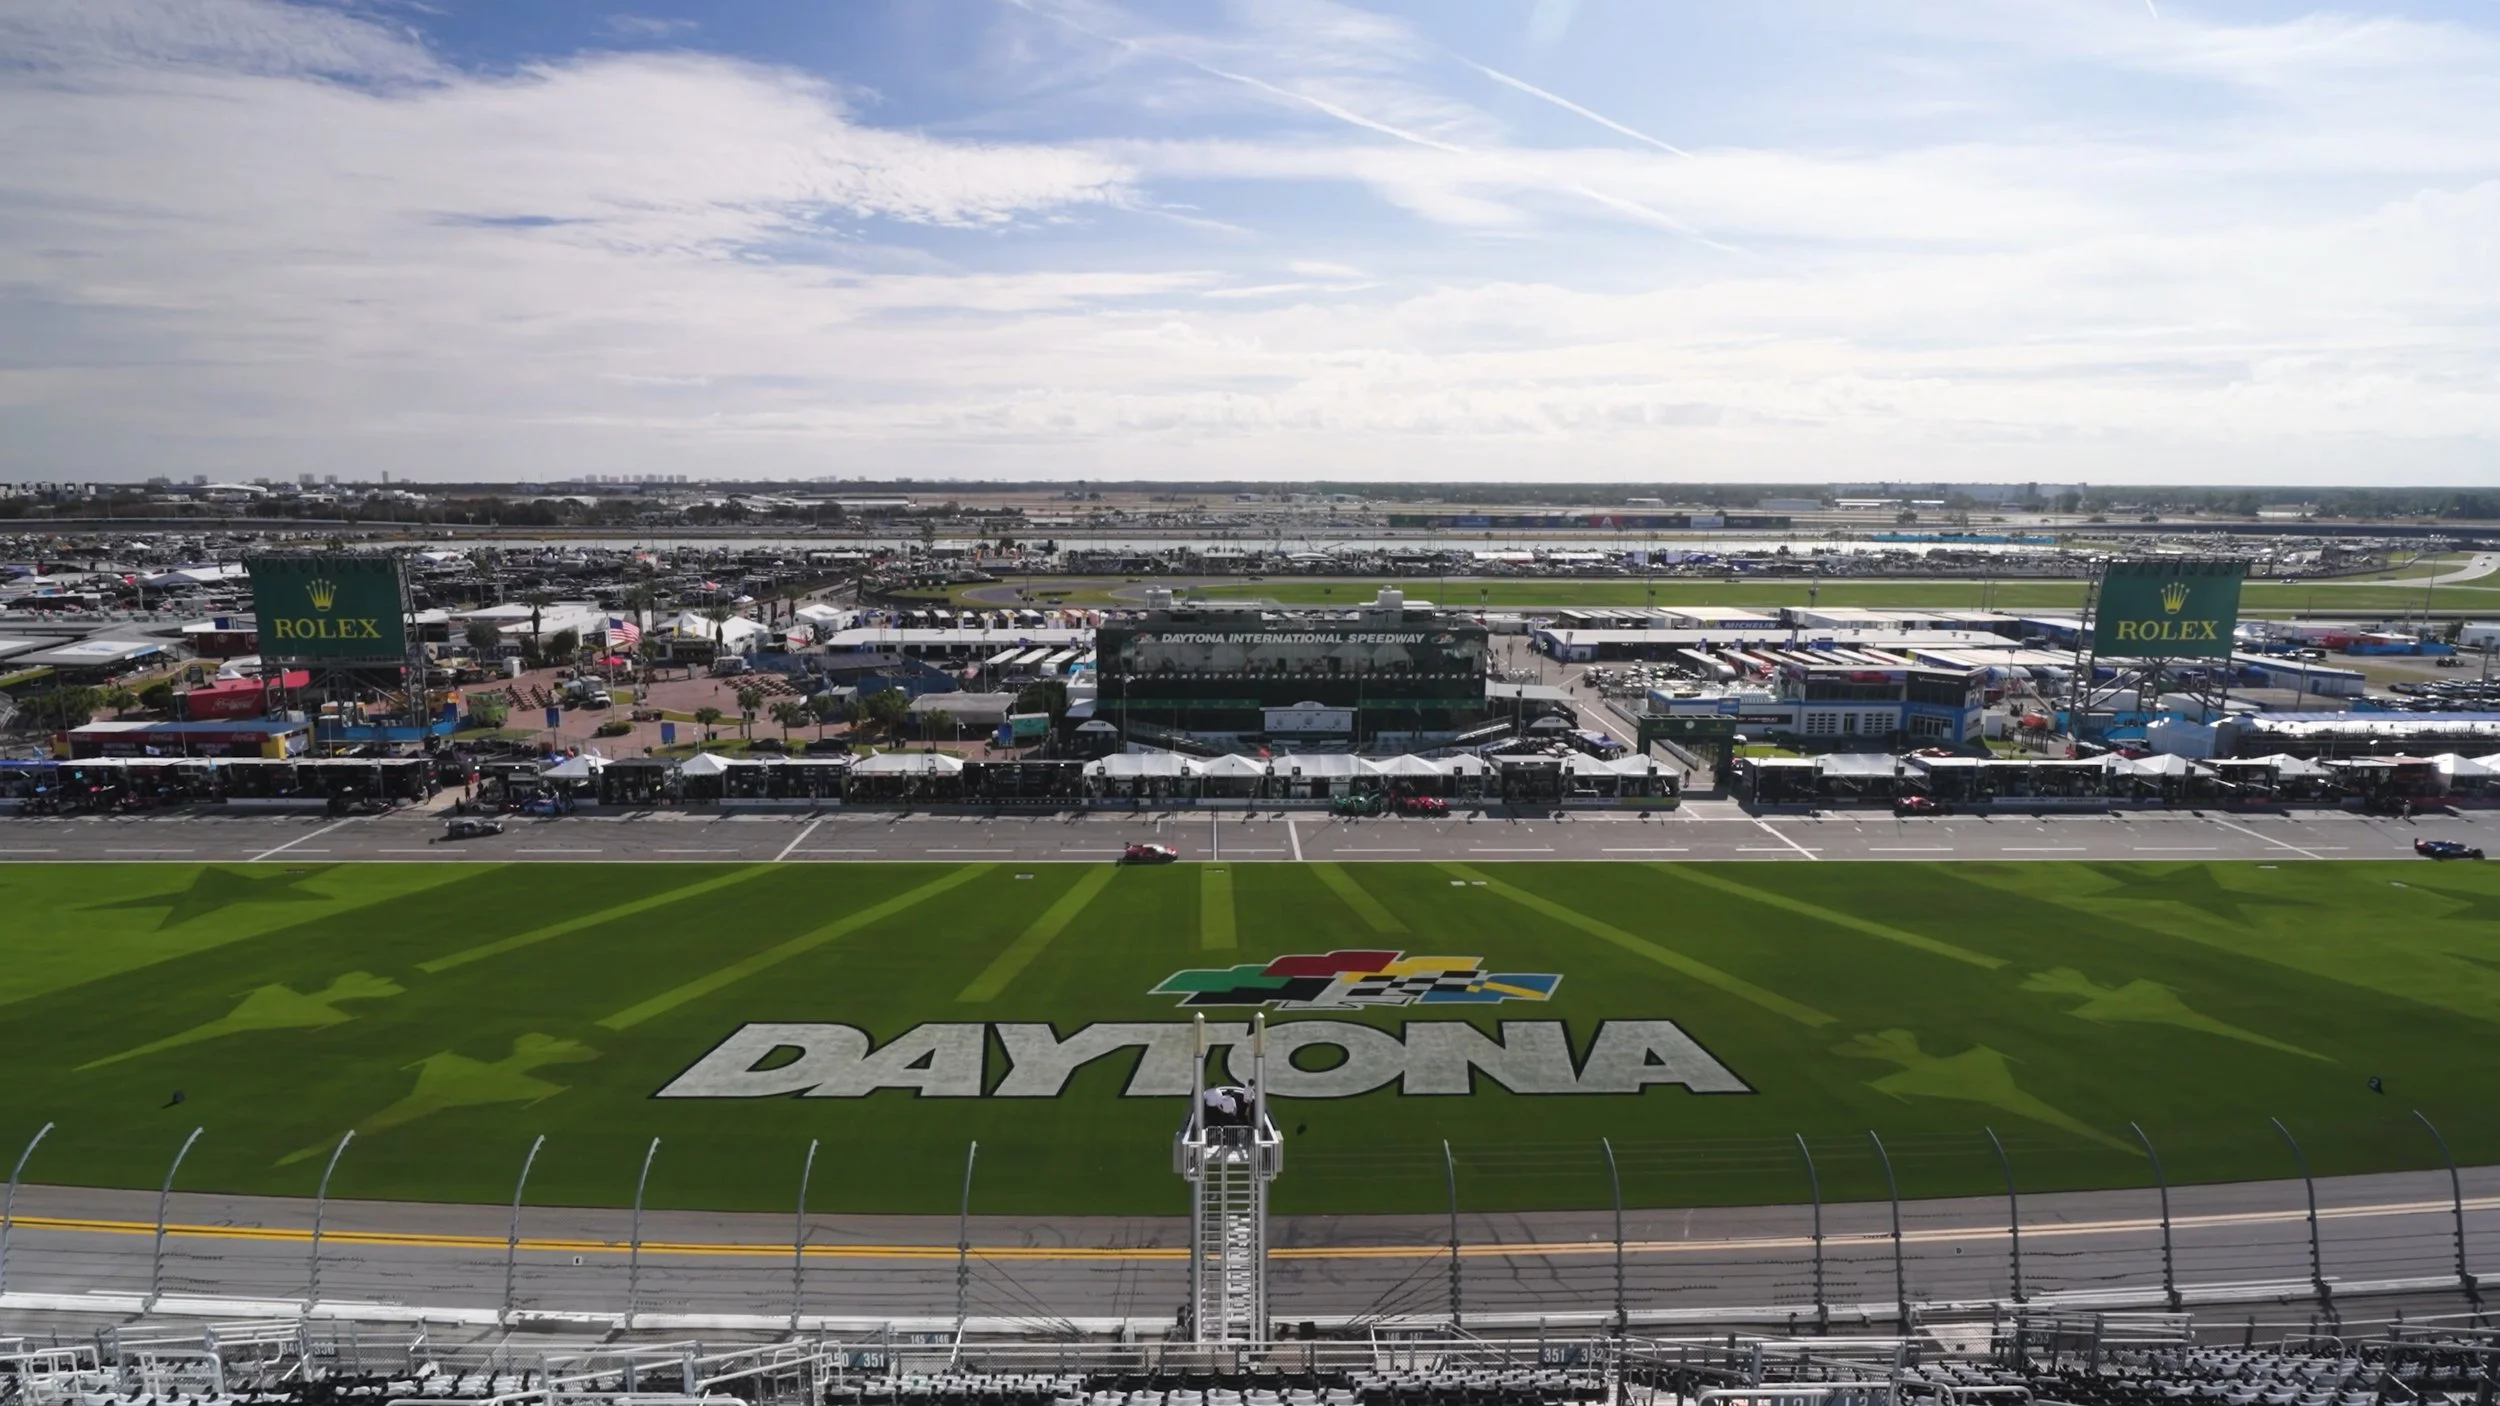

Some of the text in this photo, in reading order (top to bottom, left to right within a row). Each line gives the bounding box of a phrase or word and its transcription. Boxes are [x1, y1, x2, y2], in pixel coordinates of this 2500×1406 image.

[274, 618, 382, 639] ROLEX
[1724, 621, 1777, 629] MICHELIN
[2116, 620, 2218, 641] ROLEX
[1161, 633, 1426, 644] DAYTONA INTERNATIONAL SPEEDWAY
[655, 1019, 1758, 1099] DAYTONA
[910, 1333, 950, 1345] 145 146
[863, 1351, 885, 1368] 351
[1543, 1347, 1604, 1363] 351 352
